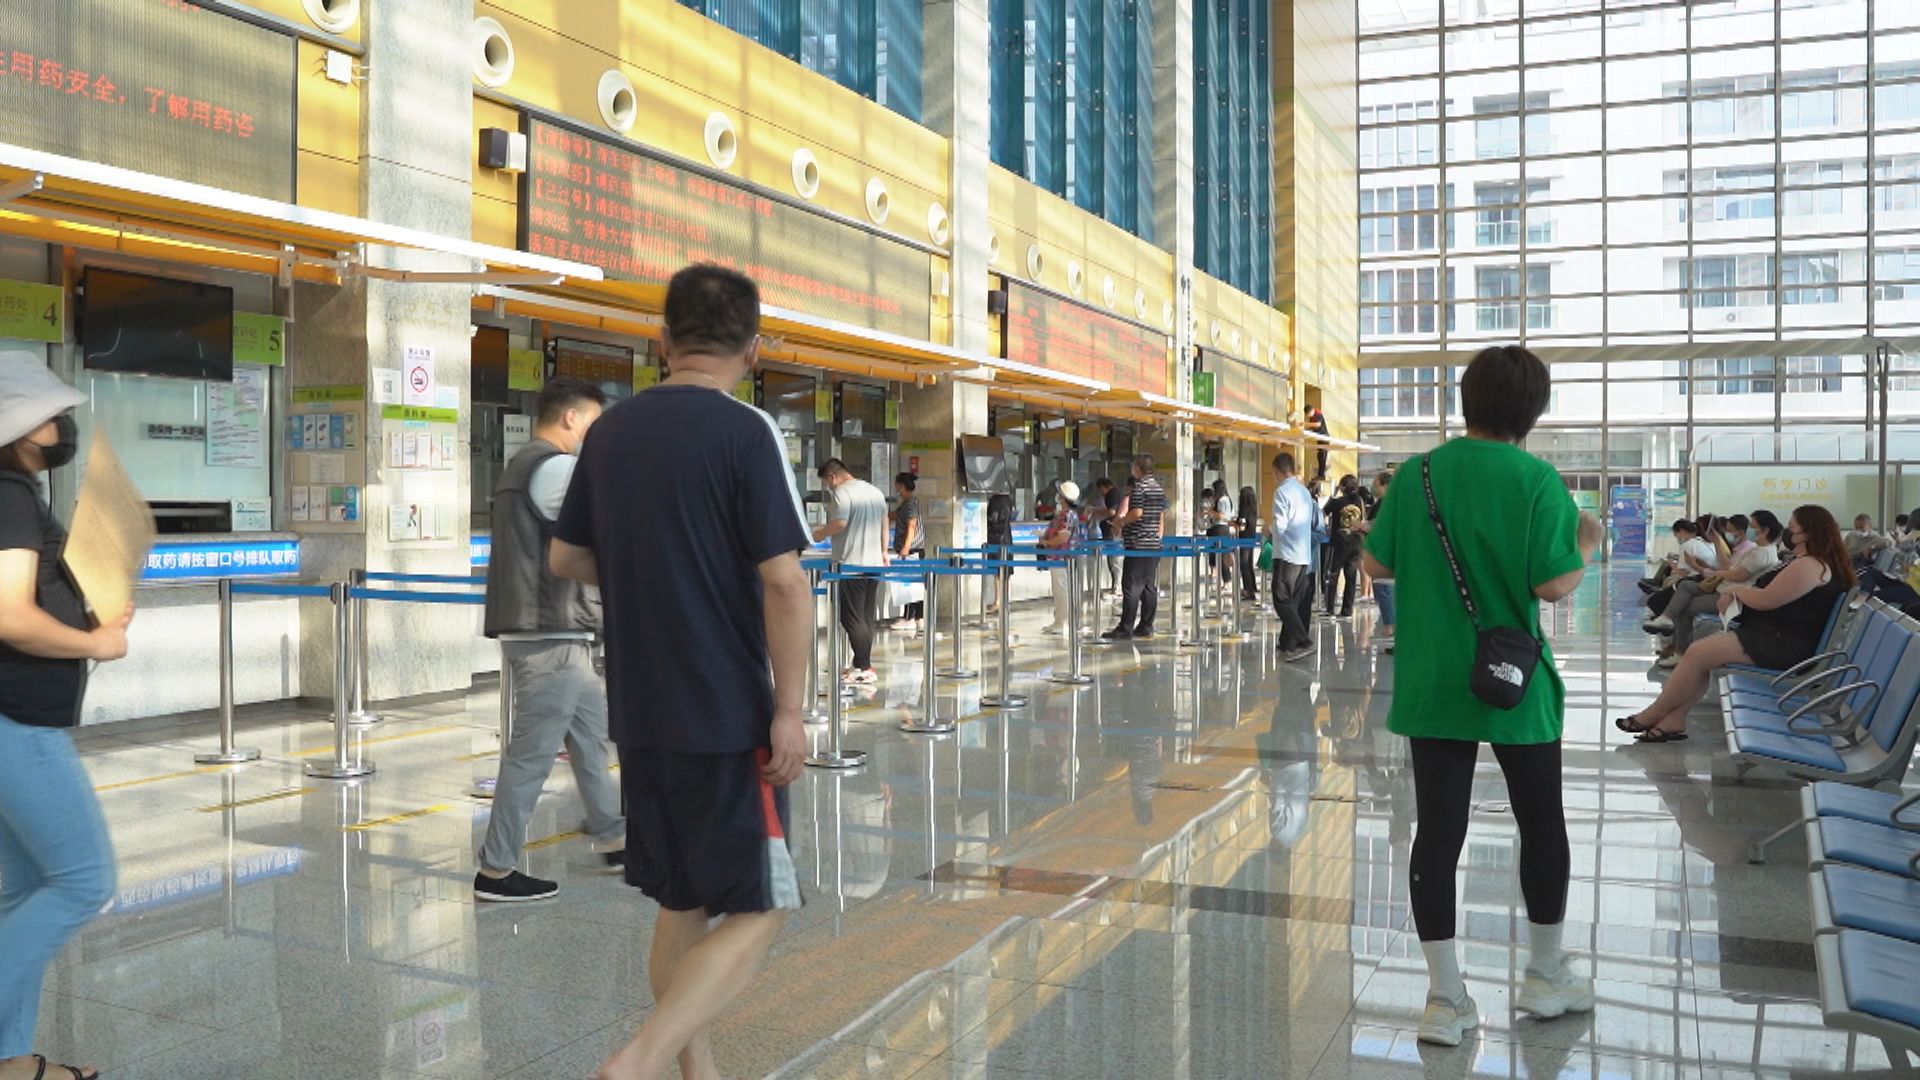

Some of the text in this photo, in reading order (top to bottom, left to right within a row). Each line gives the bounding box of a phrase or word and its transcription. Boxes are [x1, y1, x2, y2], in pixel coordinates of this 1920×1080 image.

[43, 302, 58, 326] 4
[269, 330, 280, 351] 5
[144, 550, 297, 569] 取药请按窗口号排队取药
